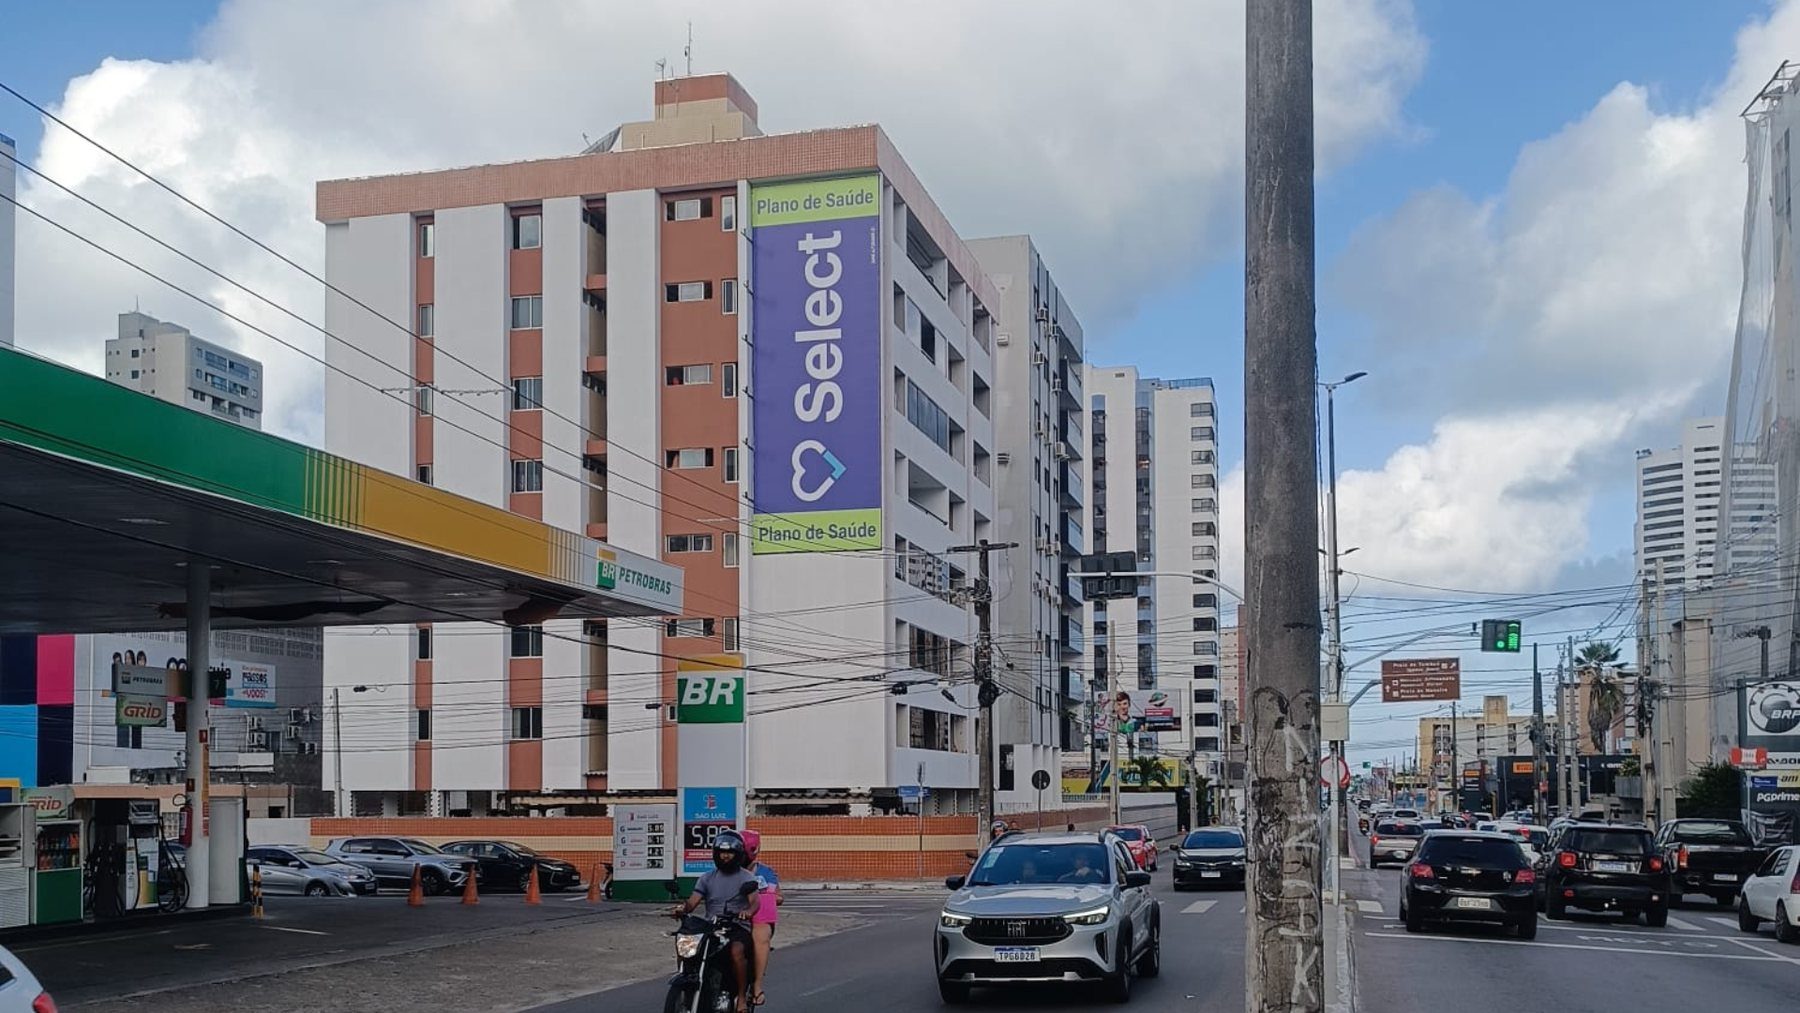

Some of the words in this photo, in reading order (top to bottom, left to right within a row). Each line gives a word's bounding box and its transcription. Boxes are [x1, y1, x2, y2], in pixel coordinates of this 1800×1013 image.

[757, 199, 799, 215] Plano
[803, 194, 822, 211] de
[826, 189, 874, 208] Saúde
[794, 230, 843, 423] Select
[758, 526, 801, 542] Plano
[805, 525, 824, 540] de
[828, 522, 877, 539] Saúde
[602, 562, 615, 580] BR
[619, 567, 672, 595] PETROBRAS
[681, 677, 737, 705] BR
[124, 702, 162, 719] GRID
